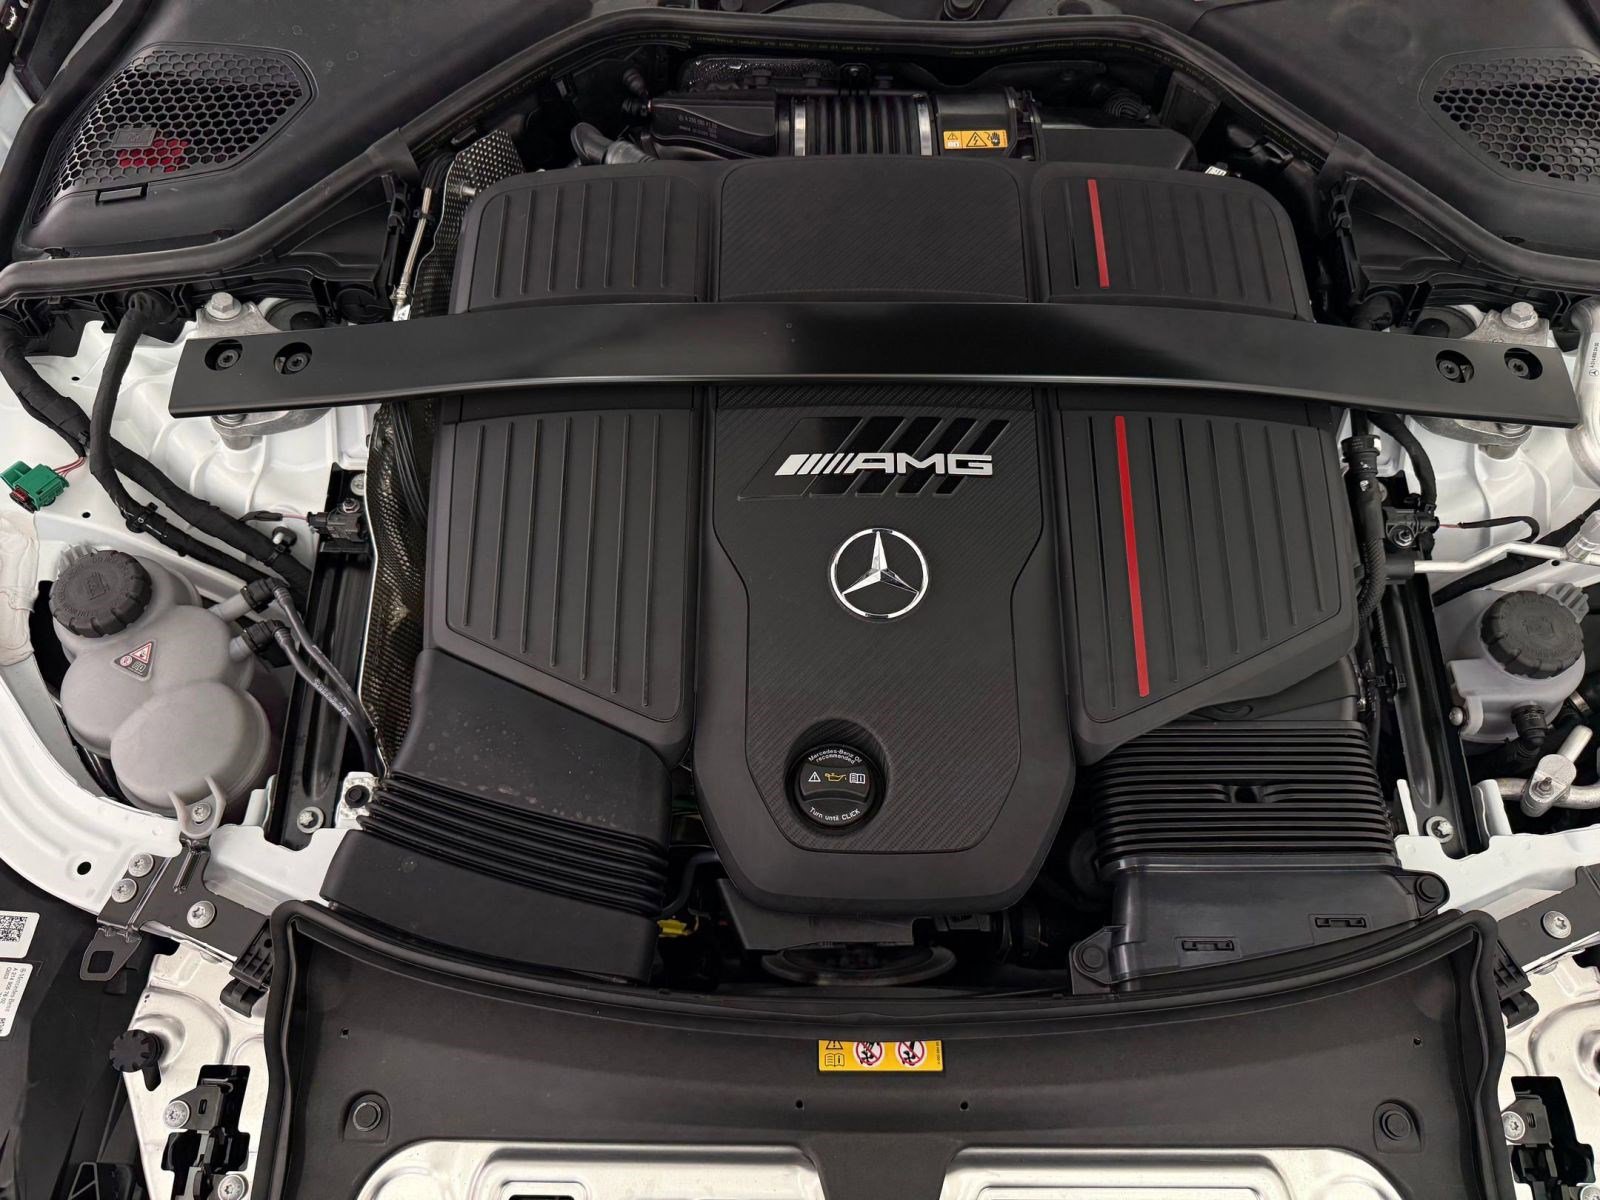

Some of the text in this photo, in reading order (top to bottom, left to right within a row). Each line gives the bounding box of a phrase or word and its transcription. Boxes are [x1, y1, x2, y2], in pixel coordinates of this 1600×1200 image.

[843, 452, 993, 475] AMG
[808, 749, 854, 761] Mercedes-Benz
[815, 754, 855, 764] recommended
[809, 806, 823, 819] Turn
[841, 809, 860, 820] CLICK
